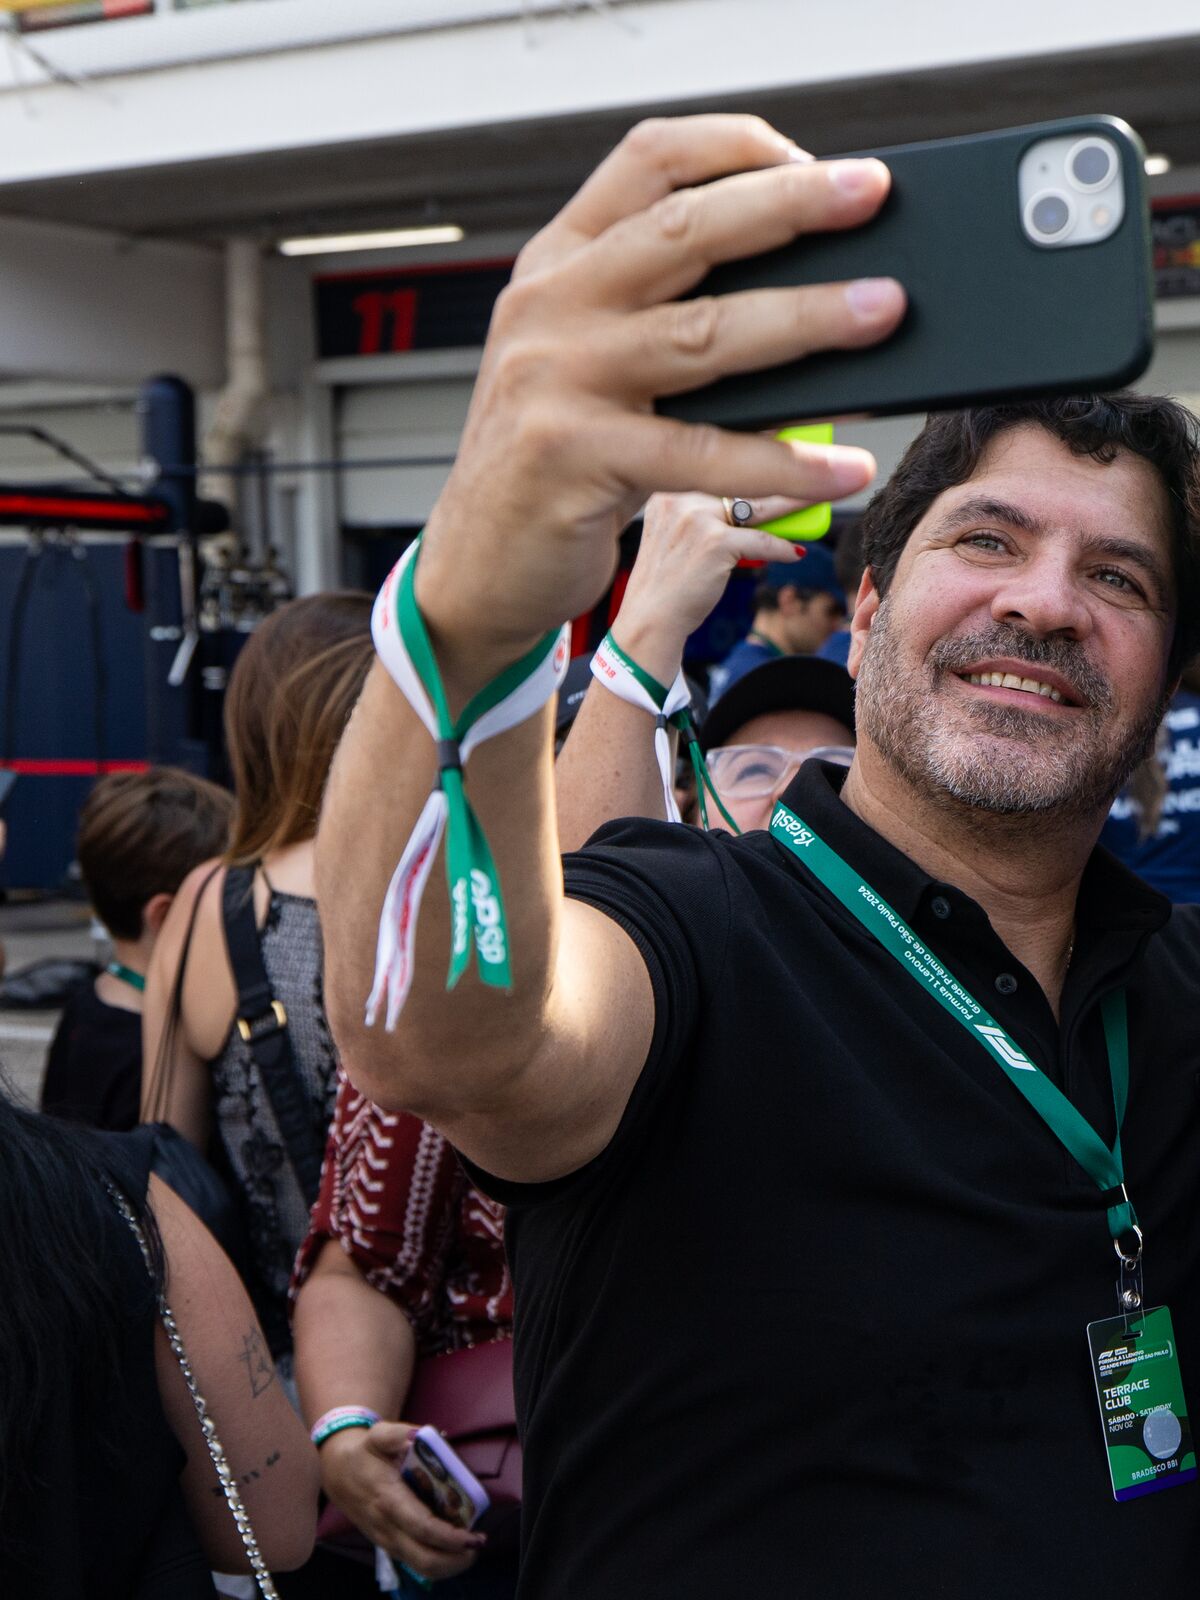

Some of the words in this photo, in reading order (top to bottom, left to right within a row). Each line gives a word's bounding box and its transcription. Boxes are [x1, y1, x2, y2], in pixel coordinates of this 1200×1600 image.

[352, 288, 417, 355] 11
[858, 885, 880, 907] 2024
[877, 903, 900, 929] Paulo
[897, 925, 915, 944] São
[912, 941, 926, 955] de
[904, 950, 936, 983] Lenovo
[923, 953, 953, 986] Prêmio
[932, 980, 941, 989] 1
[939, 986, 974, 1020] Formula
[950, 983, 981, 1014] Grande
[1103, 1379, 1150, 1399] TERRACE
[1105, 1395, 1132, 1410] CLUB
[1108, 1412, 1135, 1425] SÁBADO
[1109, 1423, 1124, 1433] NOV
[1124, 1420, 1134, 1430] 02
[1131, 1463, 1166, 1481] BRADESCO
